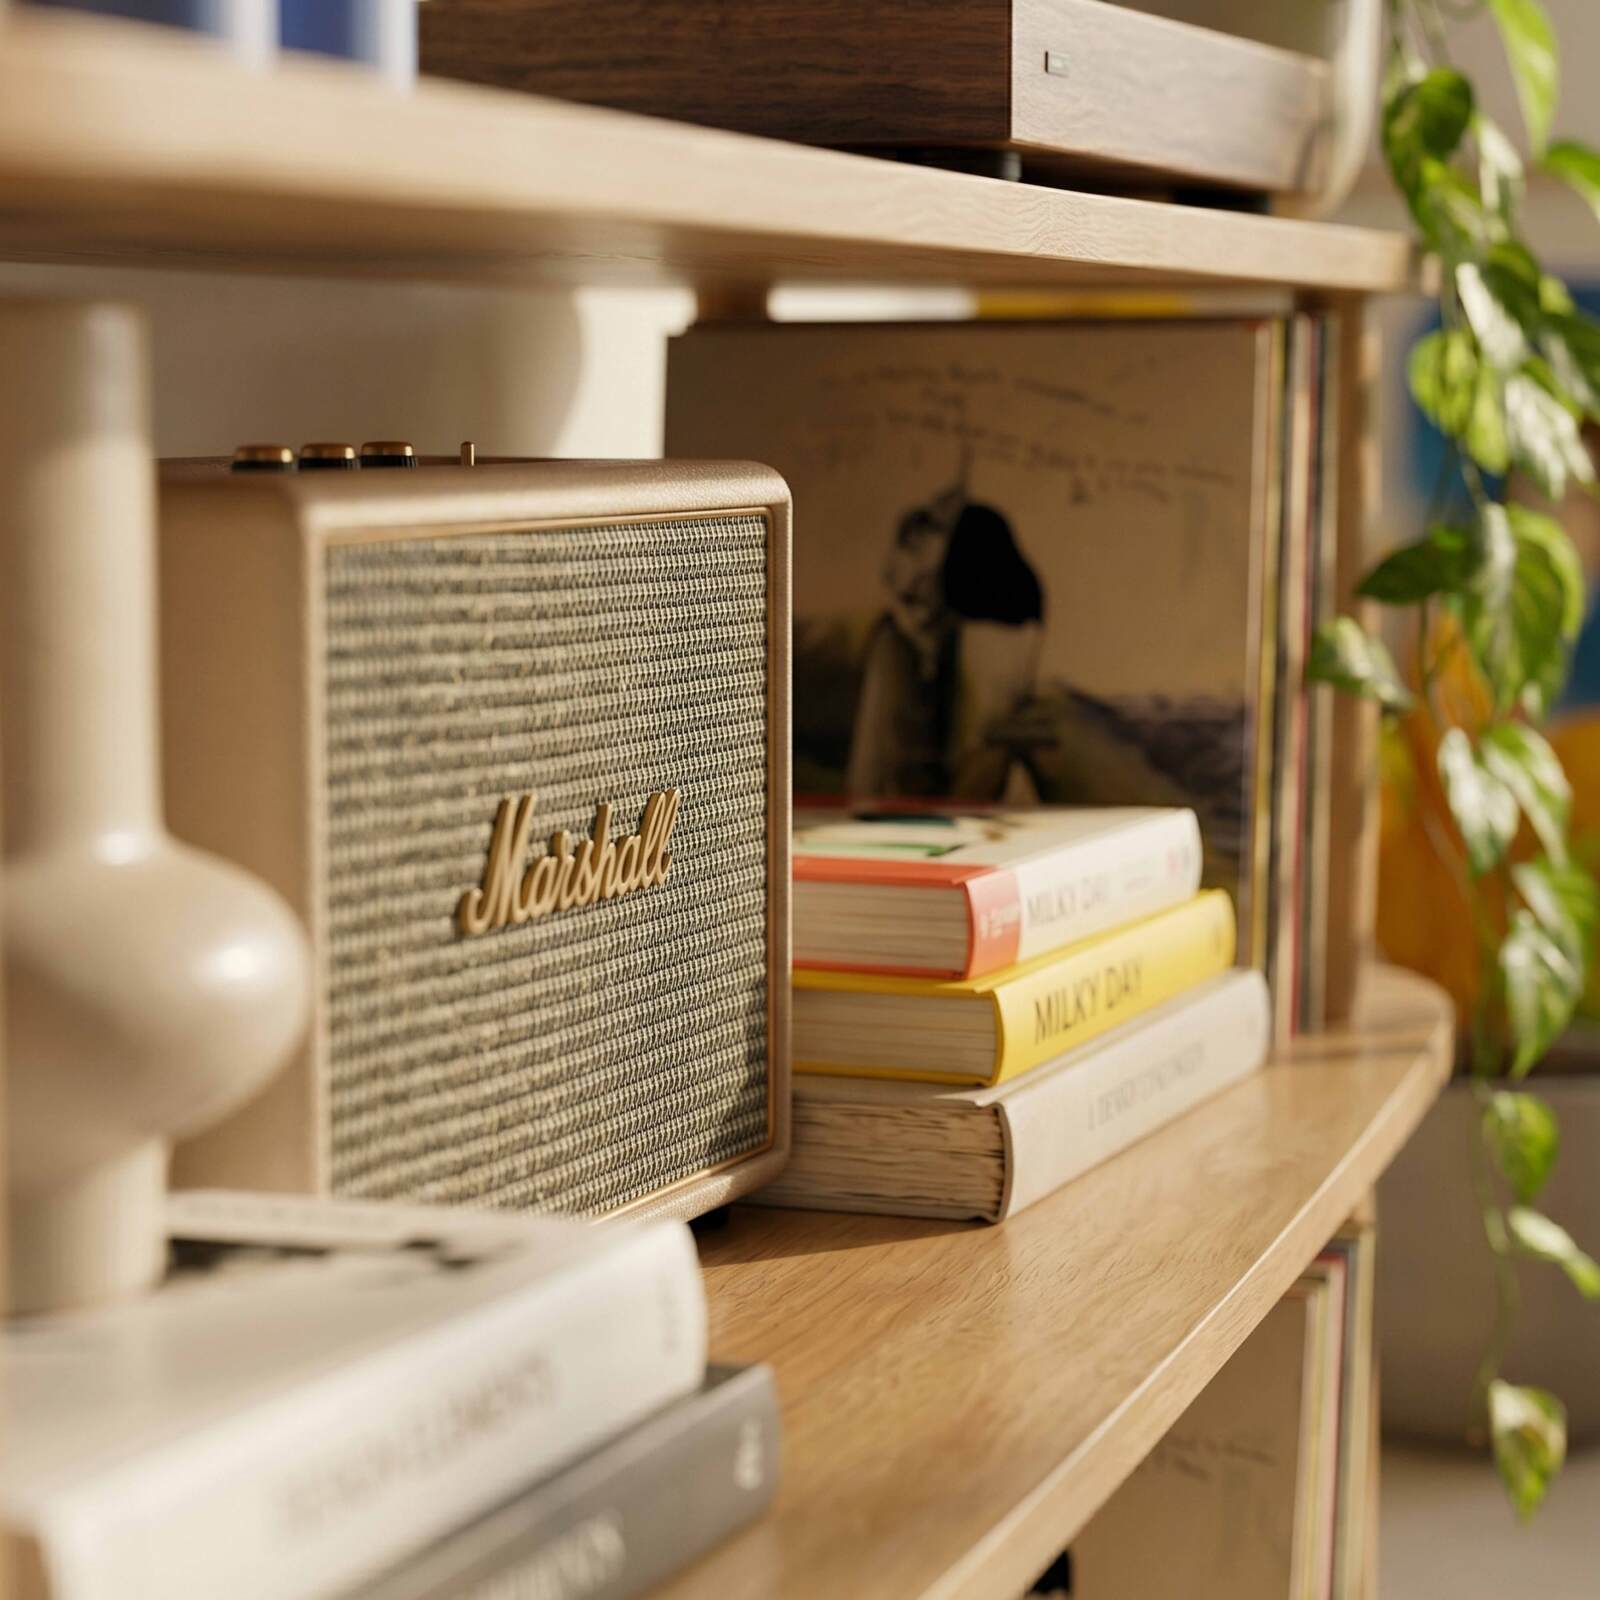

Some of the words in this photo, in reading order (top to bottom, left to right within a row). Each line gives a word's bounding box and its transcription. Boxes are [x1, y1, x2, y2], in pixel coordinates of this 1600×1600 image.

[459, 786, 682, 935] Marshall
[1034, 971, 1099, 1046] MILKY
[1104, 954, 1143, 1012] DAY
